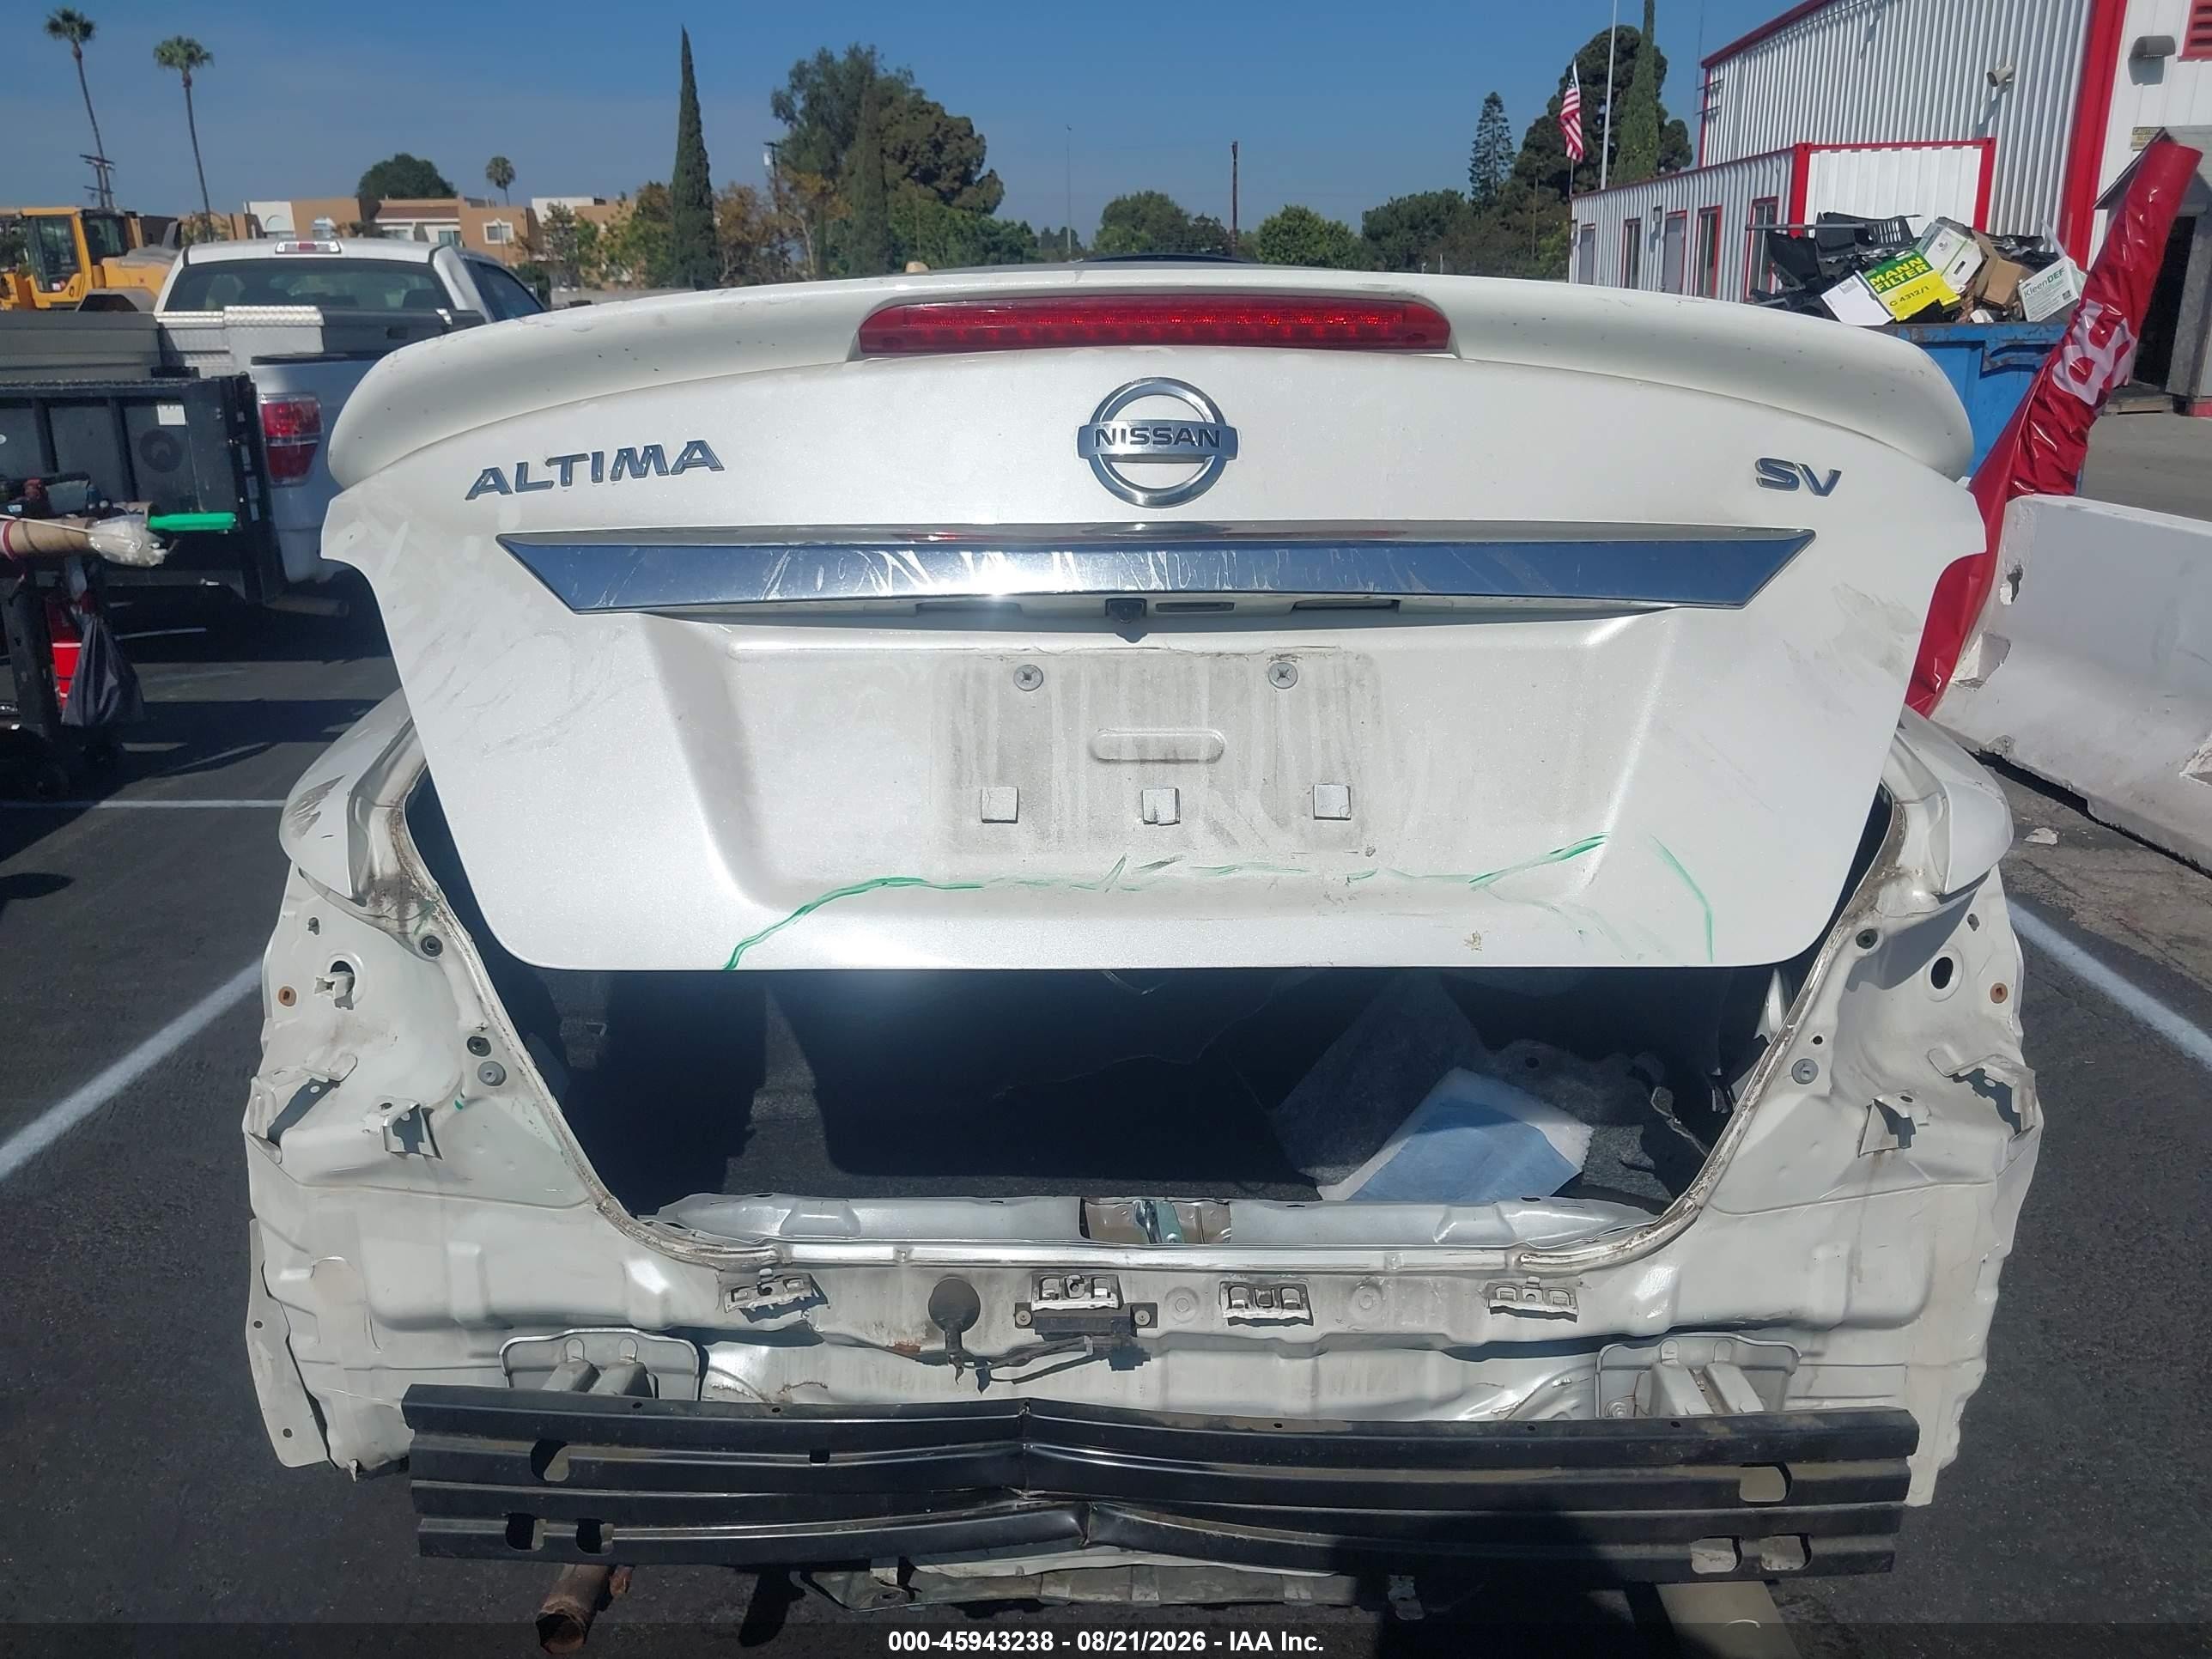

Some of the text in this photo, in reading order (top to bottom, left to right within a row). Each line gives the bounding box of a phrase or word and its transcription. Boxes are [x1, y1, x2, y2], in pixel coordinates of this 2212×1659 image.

[1869, 258, 1923, 285] MANN
[1875, 264, 1929, 292] FILTER
[2024, 267, 2065, 298] KleenDEF
[1095, 428, 1220, 447] NISSAN
[465, 440, 725, 501] ALTIMA
[1754, 458, 1842, 497] SV
